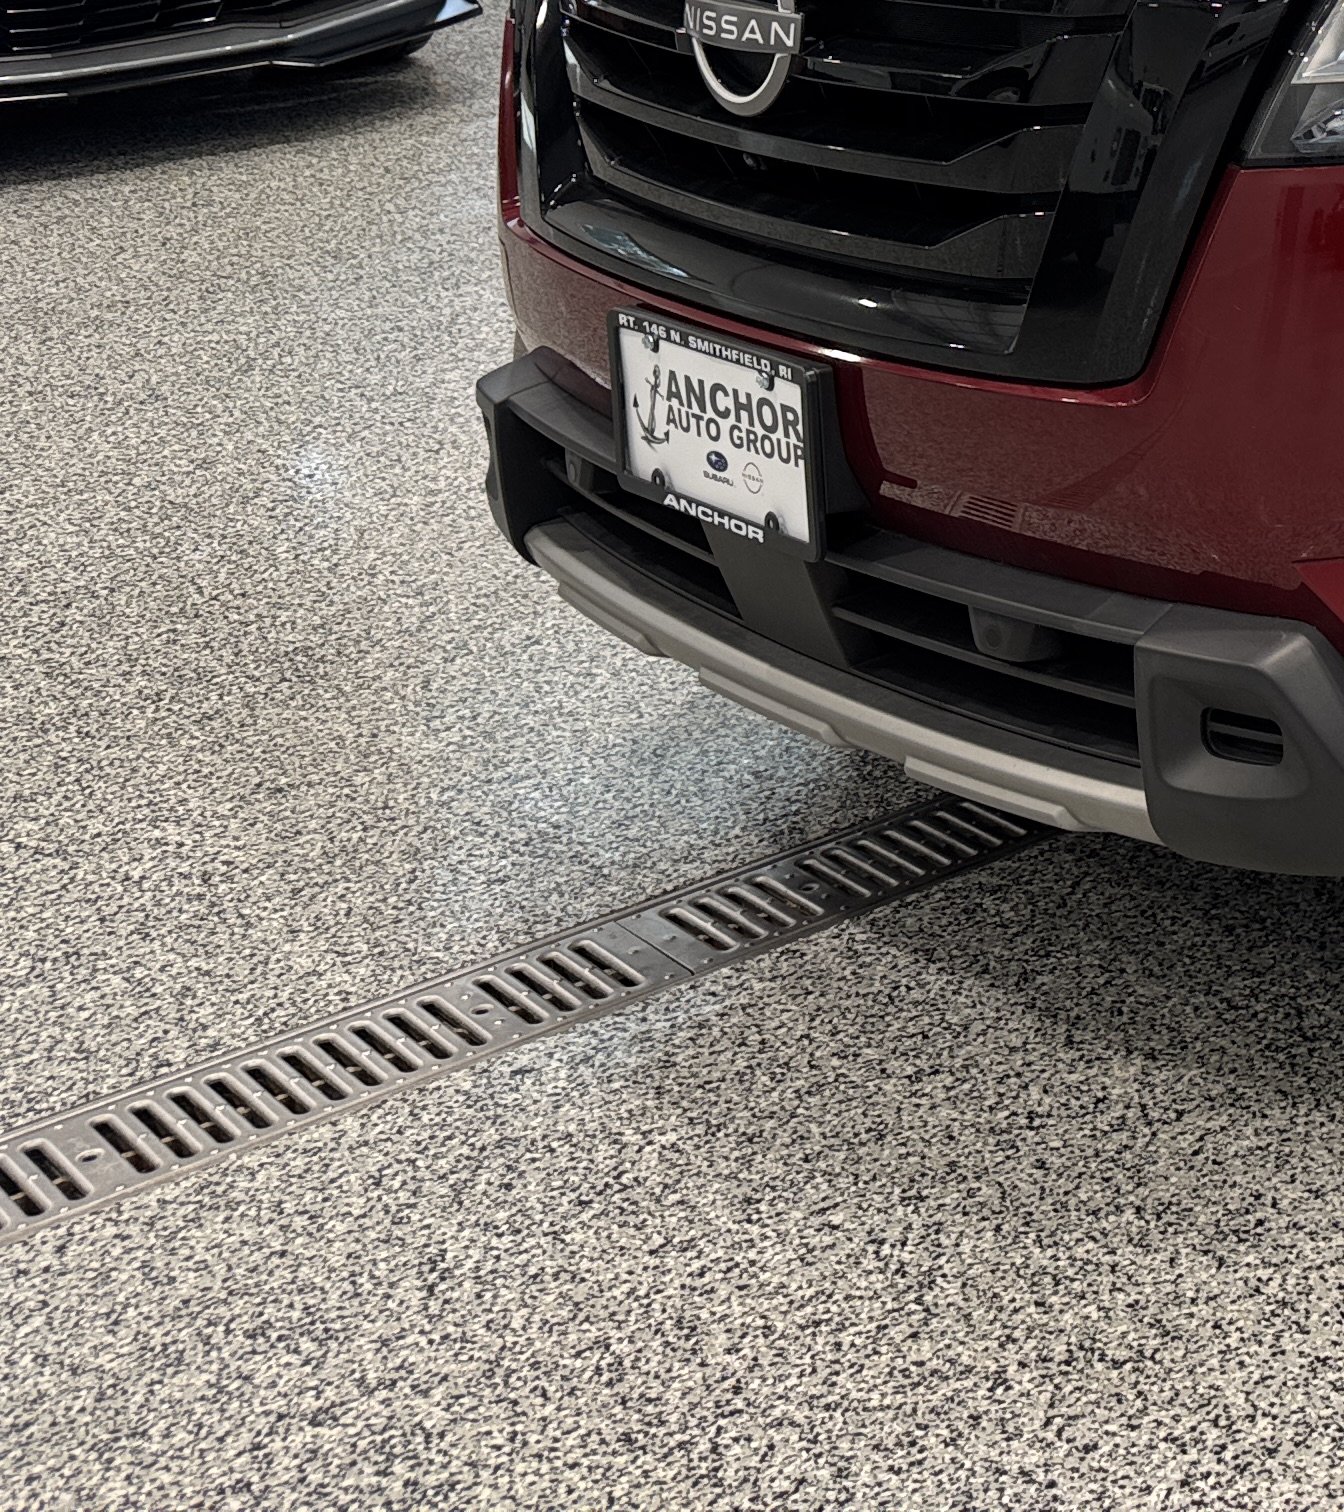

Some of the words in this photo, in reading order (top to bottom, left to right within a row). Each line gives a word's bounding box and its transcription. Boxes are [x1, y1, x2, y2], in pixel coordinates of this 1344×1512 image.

[685, 2, 796, 48] NISSAN
[618, 313, 638, 330] RT.
[643, 321, 666, 339] 146
[670, 330, 684, 345] N.
[689, 335, 775, 375] SMITHFIELD,
[779, 365, 792, 380] RI
[665, 369, 803, 444] ANCHOR
[666, 404, 721, 443] AUTO
[729, 424, 804, 468] GROUP
[663, 493, 764, 544] ANCHOR
